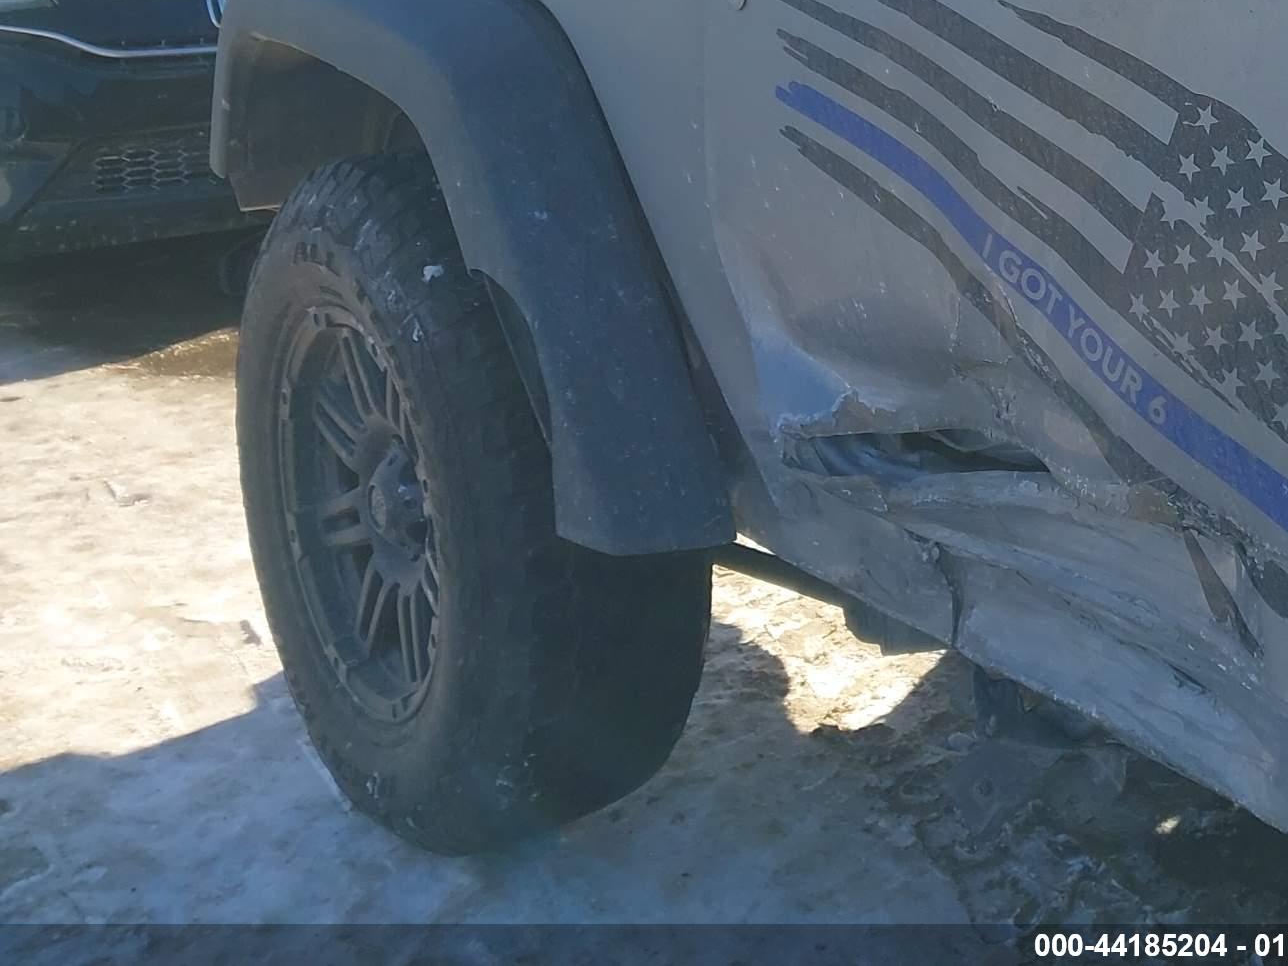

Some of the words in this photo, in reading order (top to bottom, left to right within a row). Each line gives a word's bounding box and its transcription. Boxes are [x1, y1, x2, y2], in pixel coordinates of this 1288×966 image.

[982, 233, 993, 258] I
[998, 249, 1063, 315] GOT
[1068, 307, 1143, 404] YOUR
[1149, 395, 1167, 425] 6
